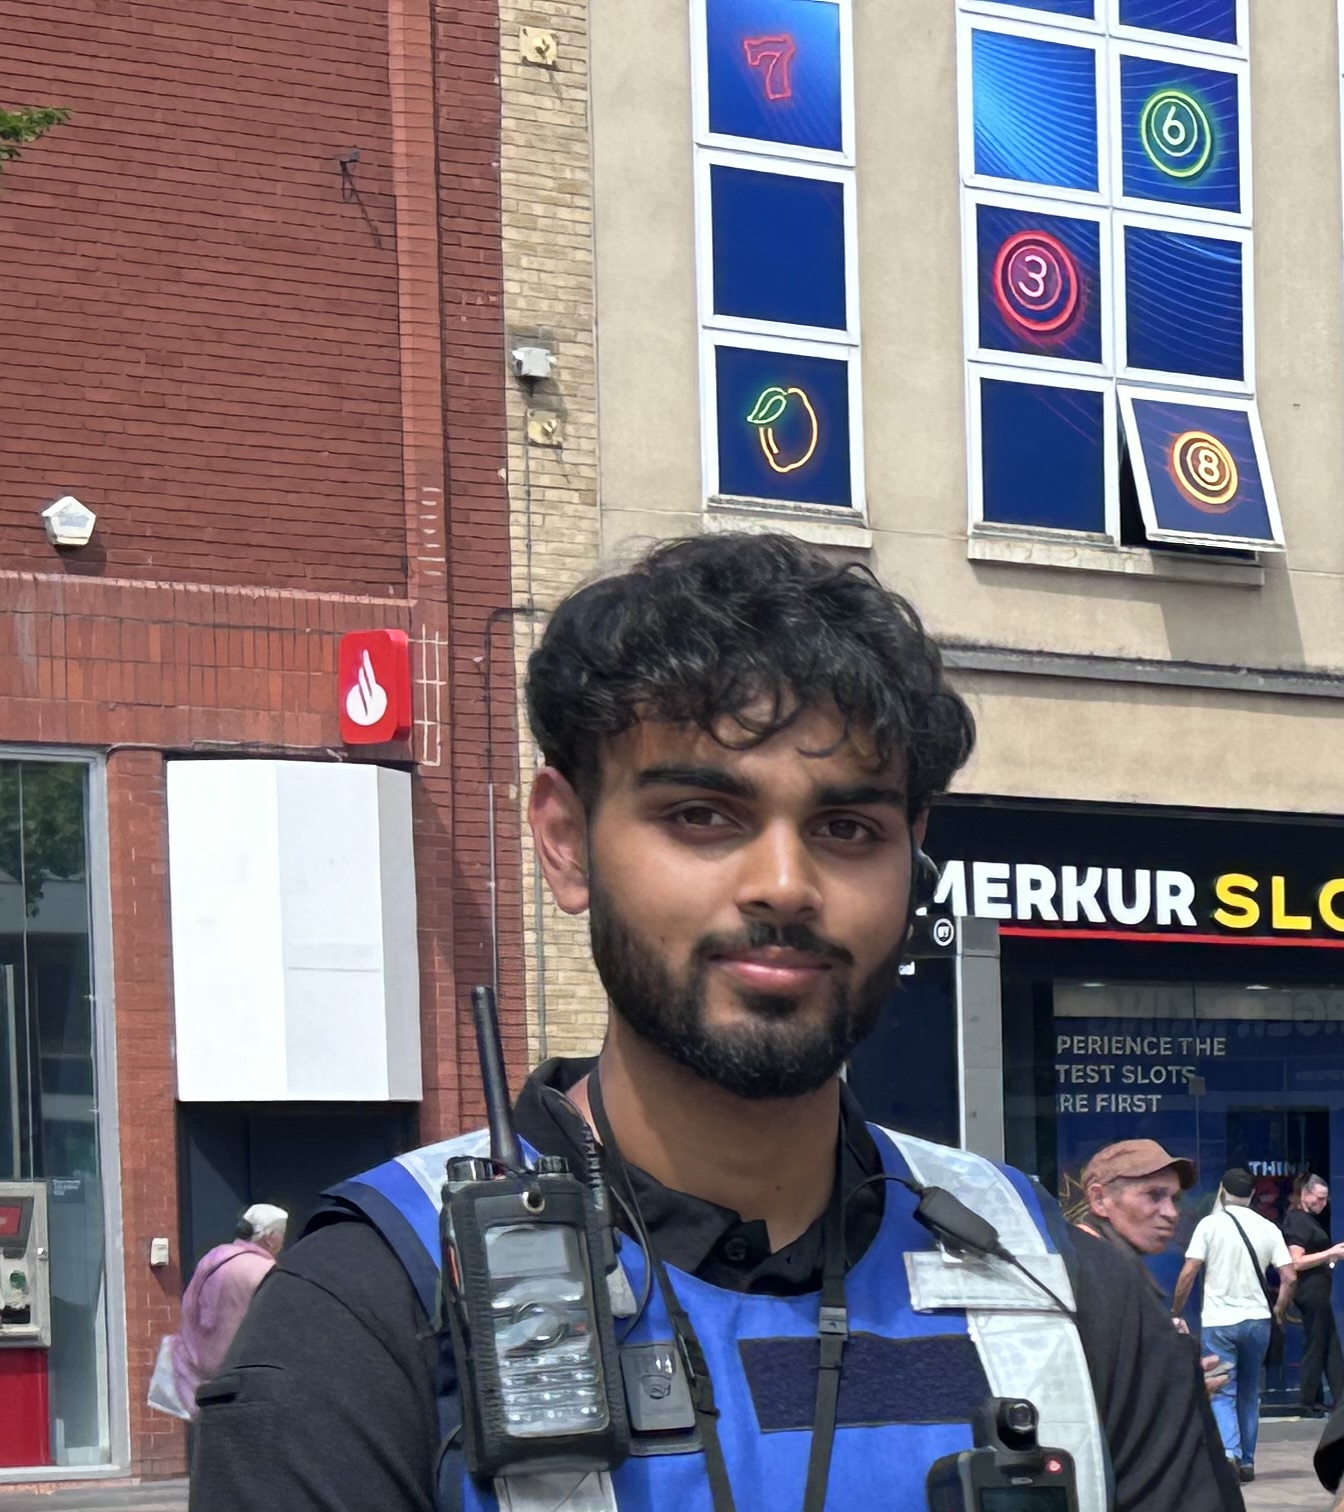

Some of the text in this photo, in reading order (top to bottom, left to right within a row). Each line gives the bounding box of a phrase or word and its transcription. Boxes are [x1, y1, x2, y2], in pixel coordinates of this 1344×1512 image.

[743, 35, 795, 100] 7
[1161, 105, 1187, 146] 6
[1017, 253, 1048, 298] 3
[1197, 447, 1221, 484] 8
[918, 860, 1198, 927] MERKUR
[1179, 1037, 1227, 1058] THE
[1055, 1063, 1197, 1085] TEST SLOTS
[1095, 1094, 1162, 1114] FIRST
